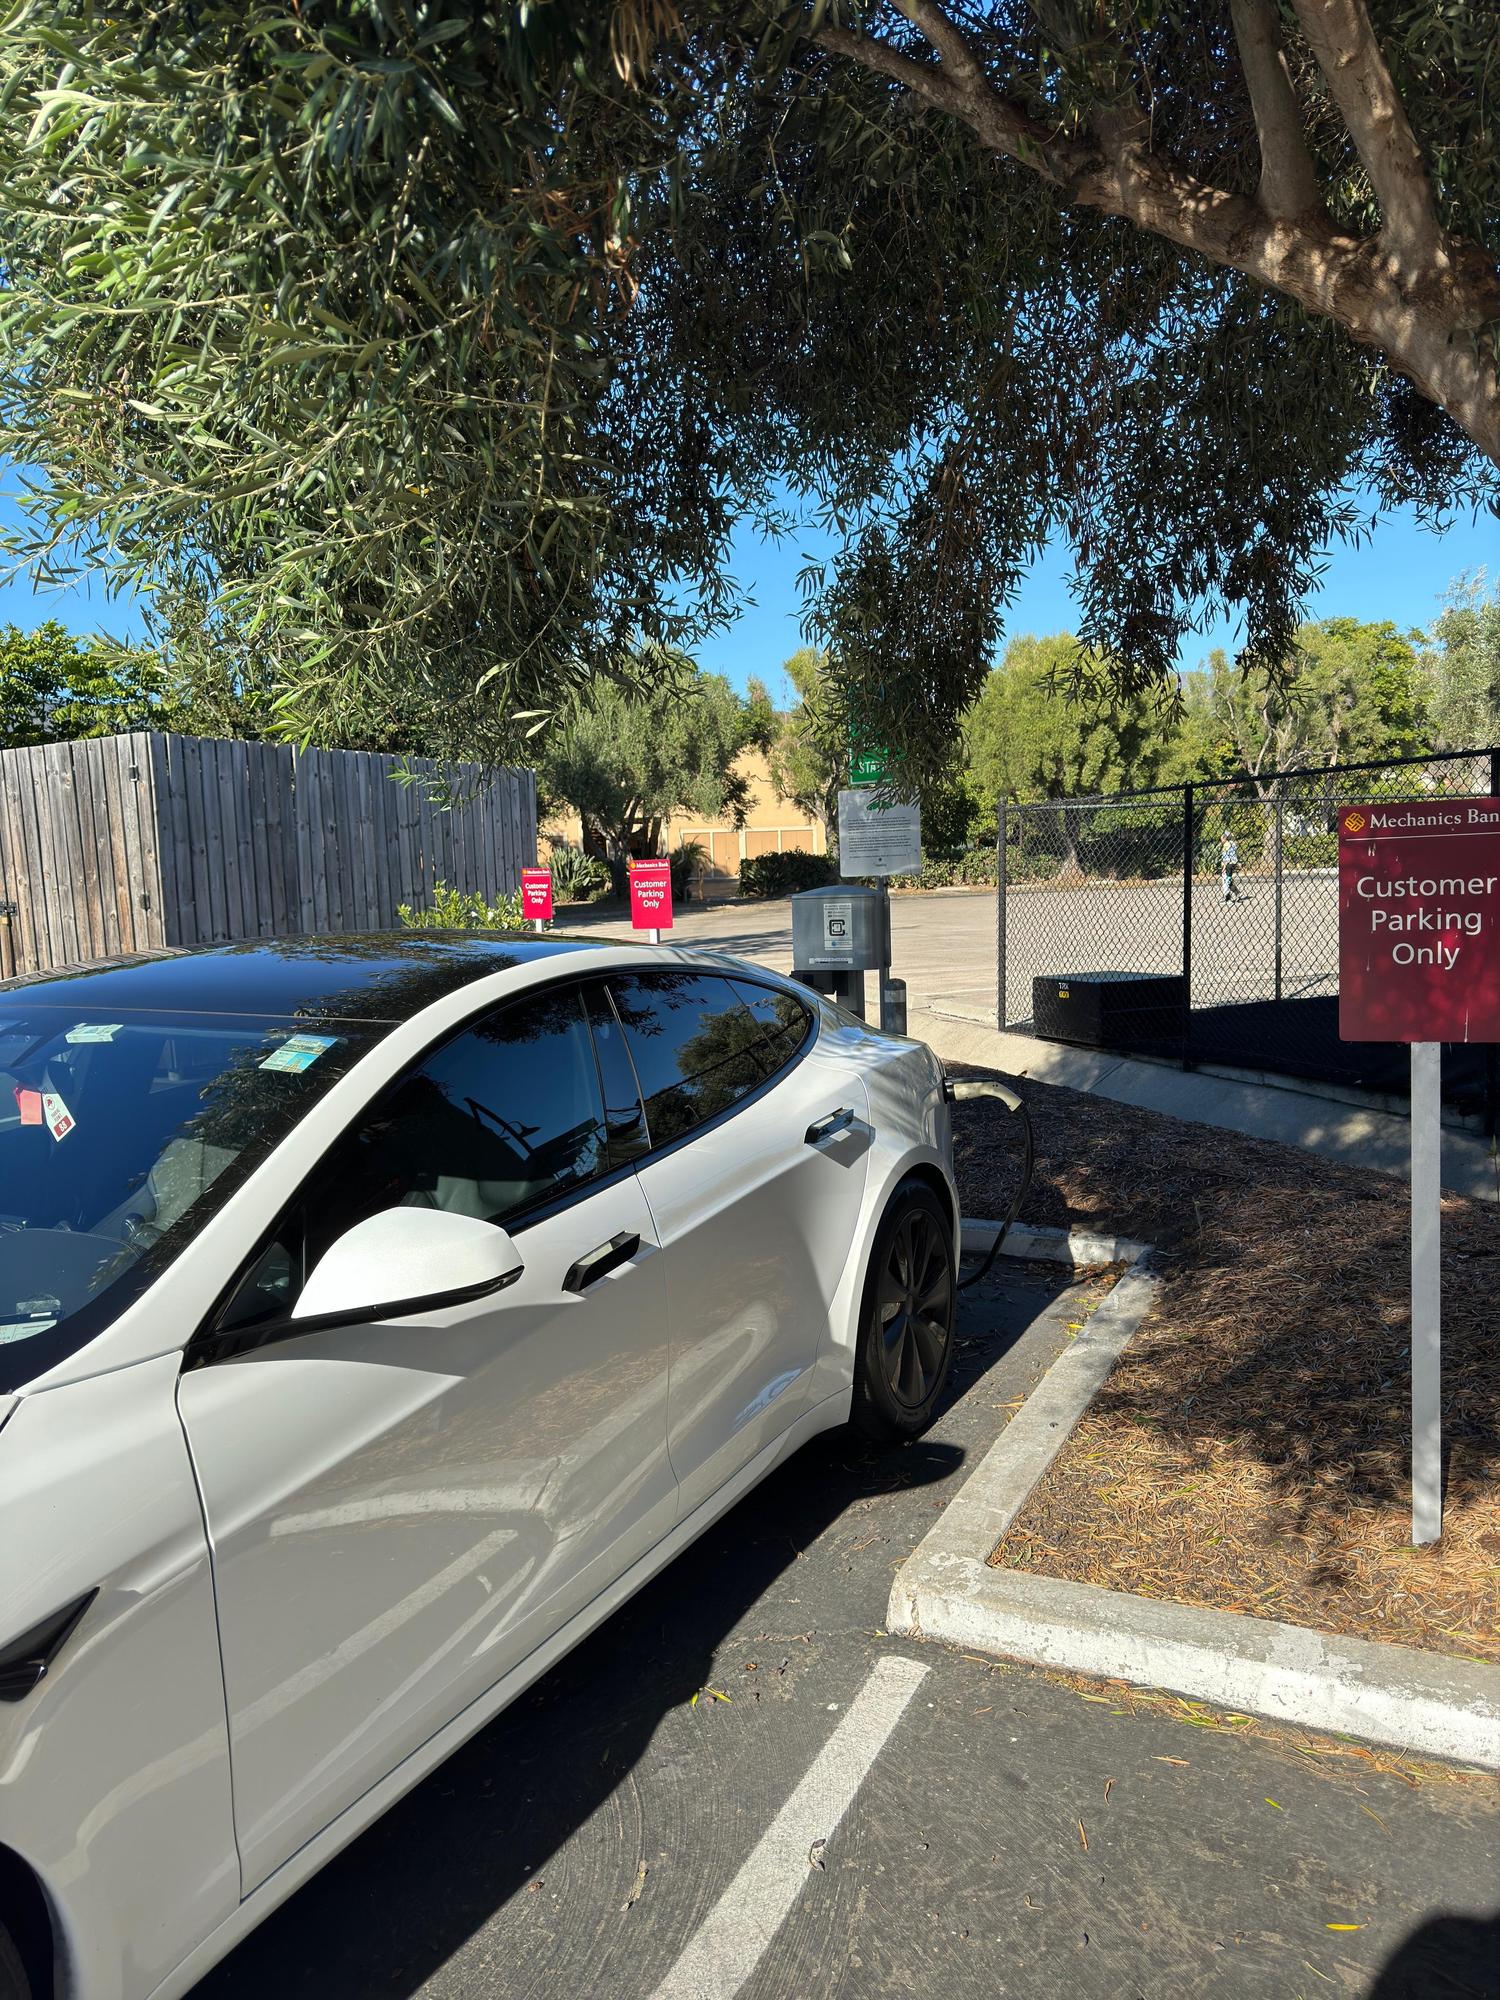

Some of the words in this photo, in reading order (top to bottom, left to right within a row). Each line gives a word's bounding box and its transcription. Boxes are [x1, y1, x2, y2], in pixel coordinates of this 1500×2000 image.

[1370, 812, 1462, 829] Mechanics
[1467, 808, 1500, 824] Ban
[634, 880, 667, 889] Customer
[1356, 876, 1498, 898] Customer
[527, 889, 547, 898] Parking
[637, 889, 664, 900] Parking
[531, 896, 544, 904] Only
[643, 899, 660, 909] Only
[1371, 908, 1482, 936] Parking
[1392, 941, 1460, 970] Only
